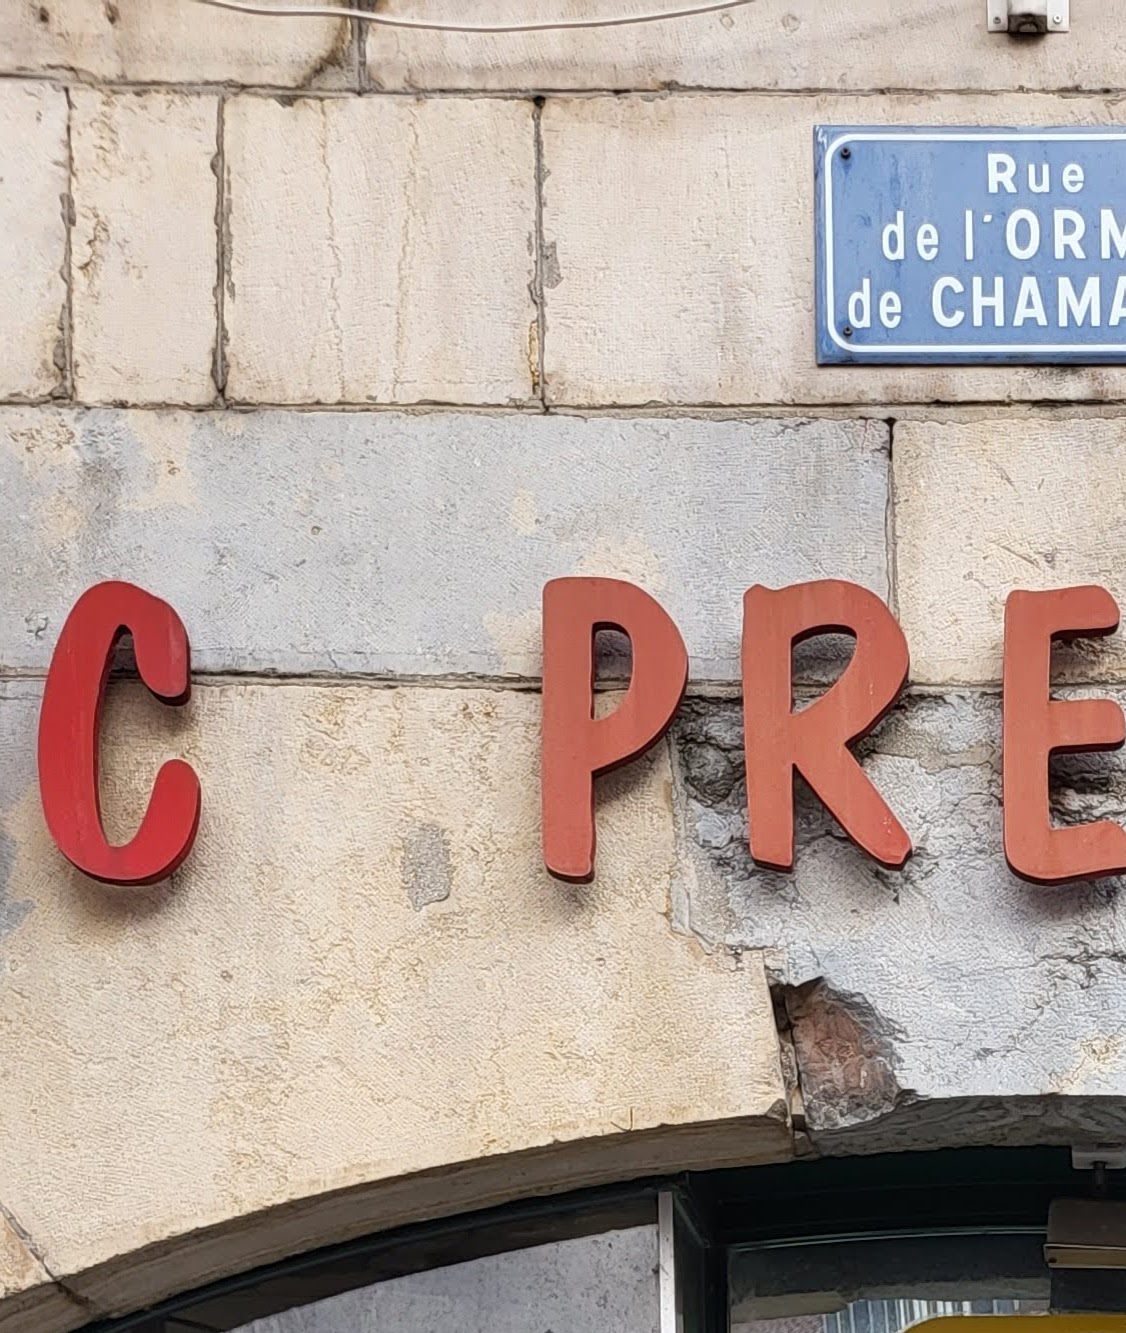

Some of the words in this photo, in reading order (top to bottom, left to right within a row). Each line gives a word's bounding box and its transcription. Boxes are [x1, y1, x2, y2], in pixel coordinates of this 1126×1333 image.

[988, 153, 1085, 194] Rue
[882, 210, 939, 261] de
[848, 278, 903, 329] de
